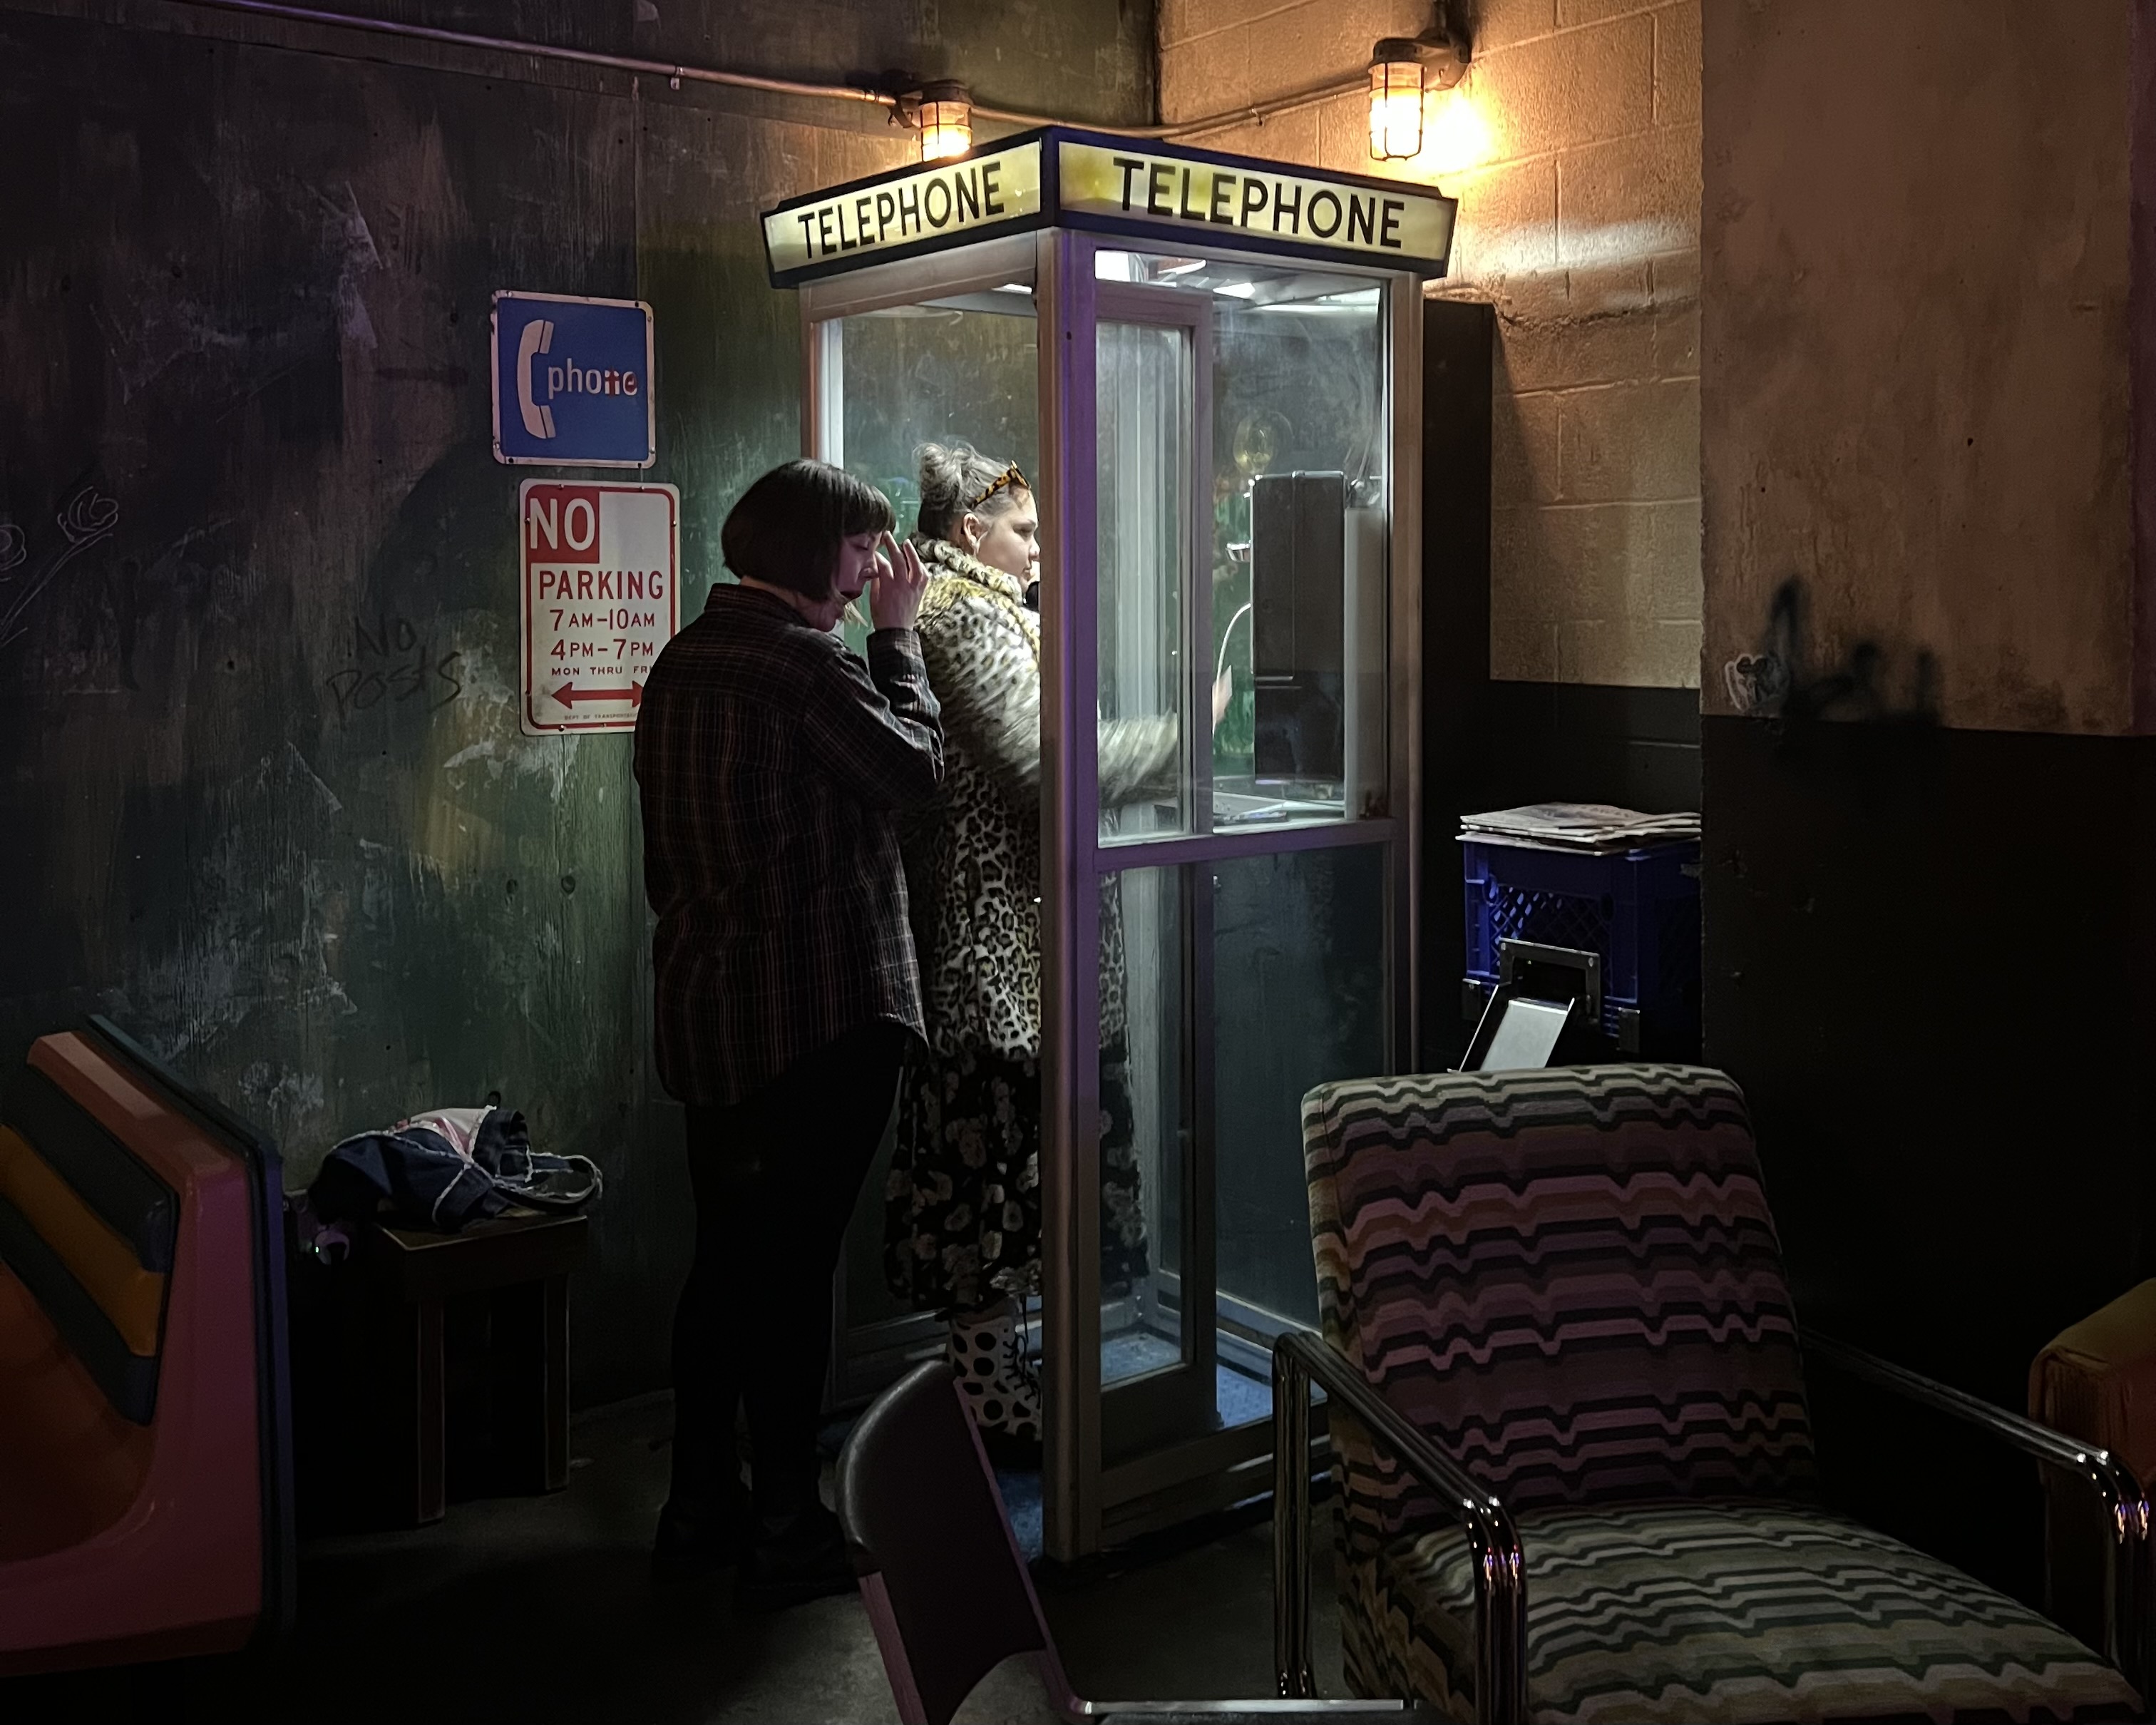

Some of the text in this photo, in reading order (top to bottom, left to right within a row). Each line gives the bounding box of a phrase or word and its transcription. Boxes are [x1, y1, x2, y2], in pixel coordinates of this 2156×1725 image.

[798, 161, 1005, 260] TELEPHONE
[1114, 158, 1405, 248] TELEPHONE
[530, 498, 595, 551] NO
[539, 570, 663, 600] PARKING
[551, 667, 580, 676] MON
[590, 666, 622, 675] THRU
